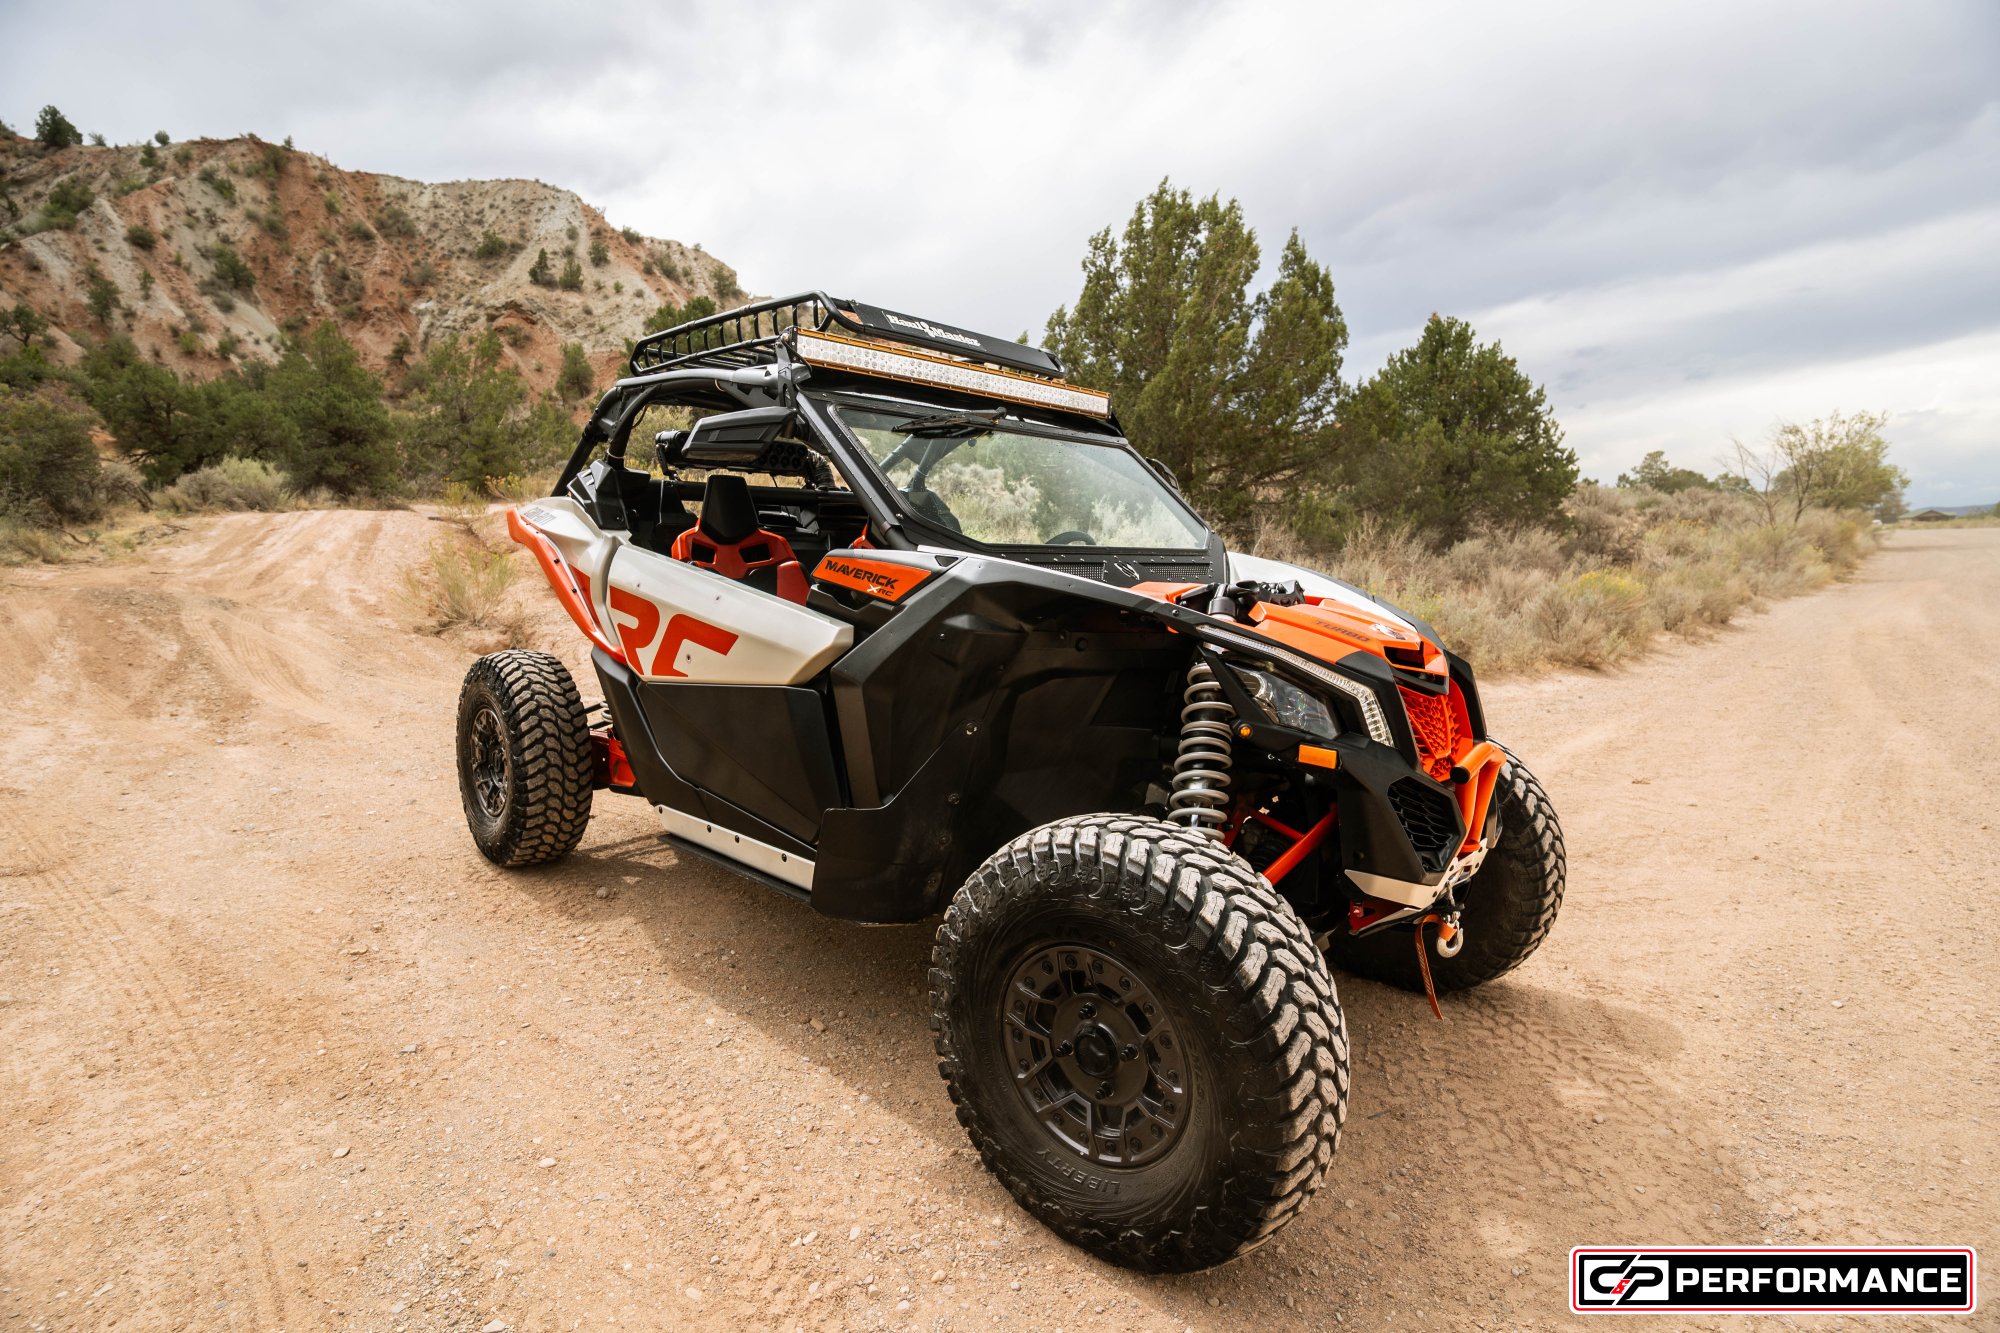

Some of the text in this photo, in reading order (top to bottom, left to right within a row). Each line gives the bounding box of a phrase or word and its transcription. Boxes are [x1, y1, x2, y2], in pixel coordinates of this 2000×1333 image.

[824, 559, 900, 590] MAVERICK
[609, 585, 739, 678] RC
[1315, 619, 1371, 642] TURBO
[1035, 1147, 1120, 1195] LIBERTY
